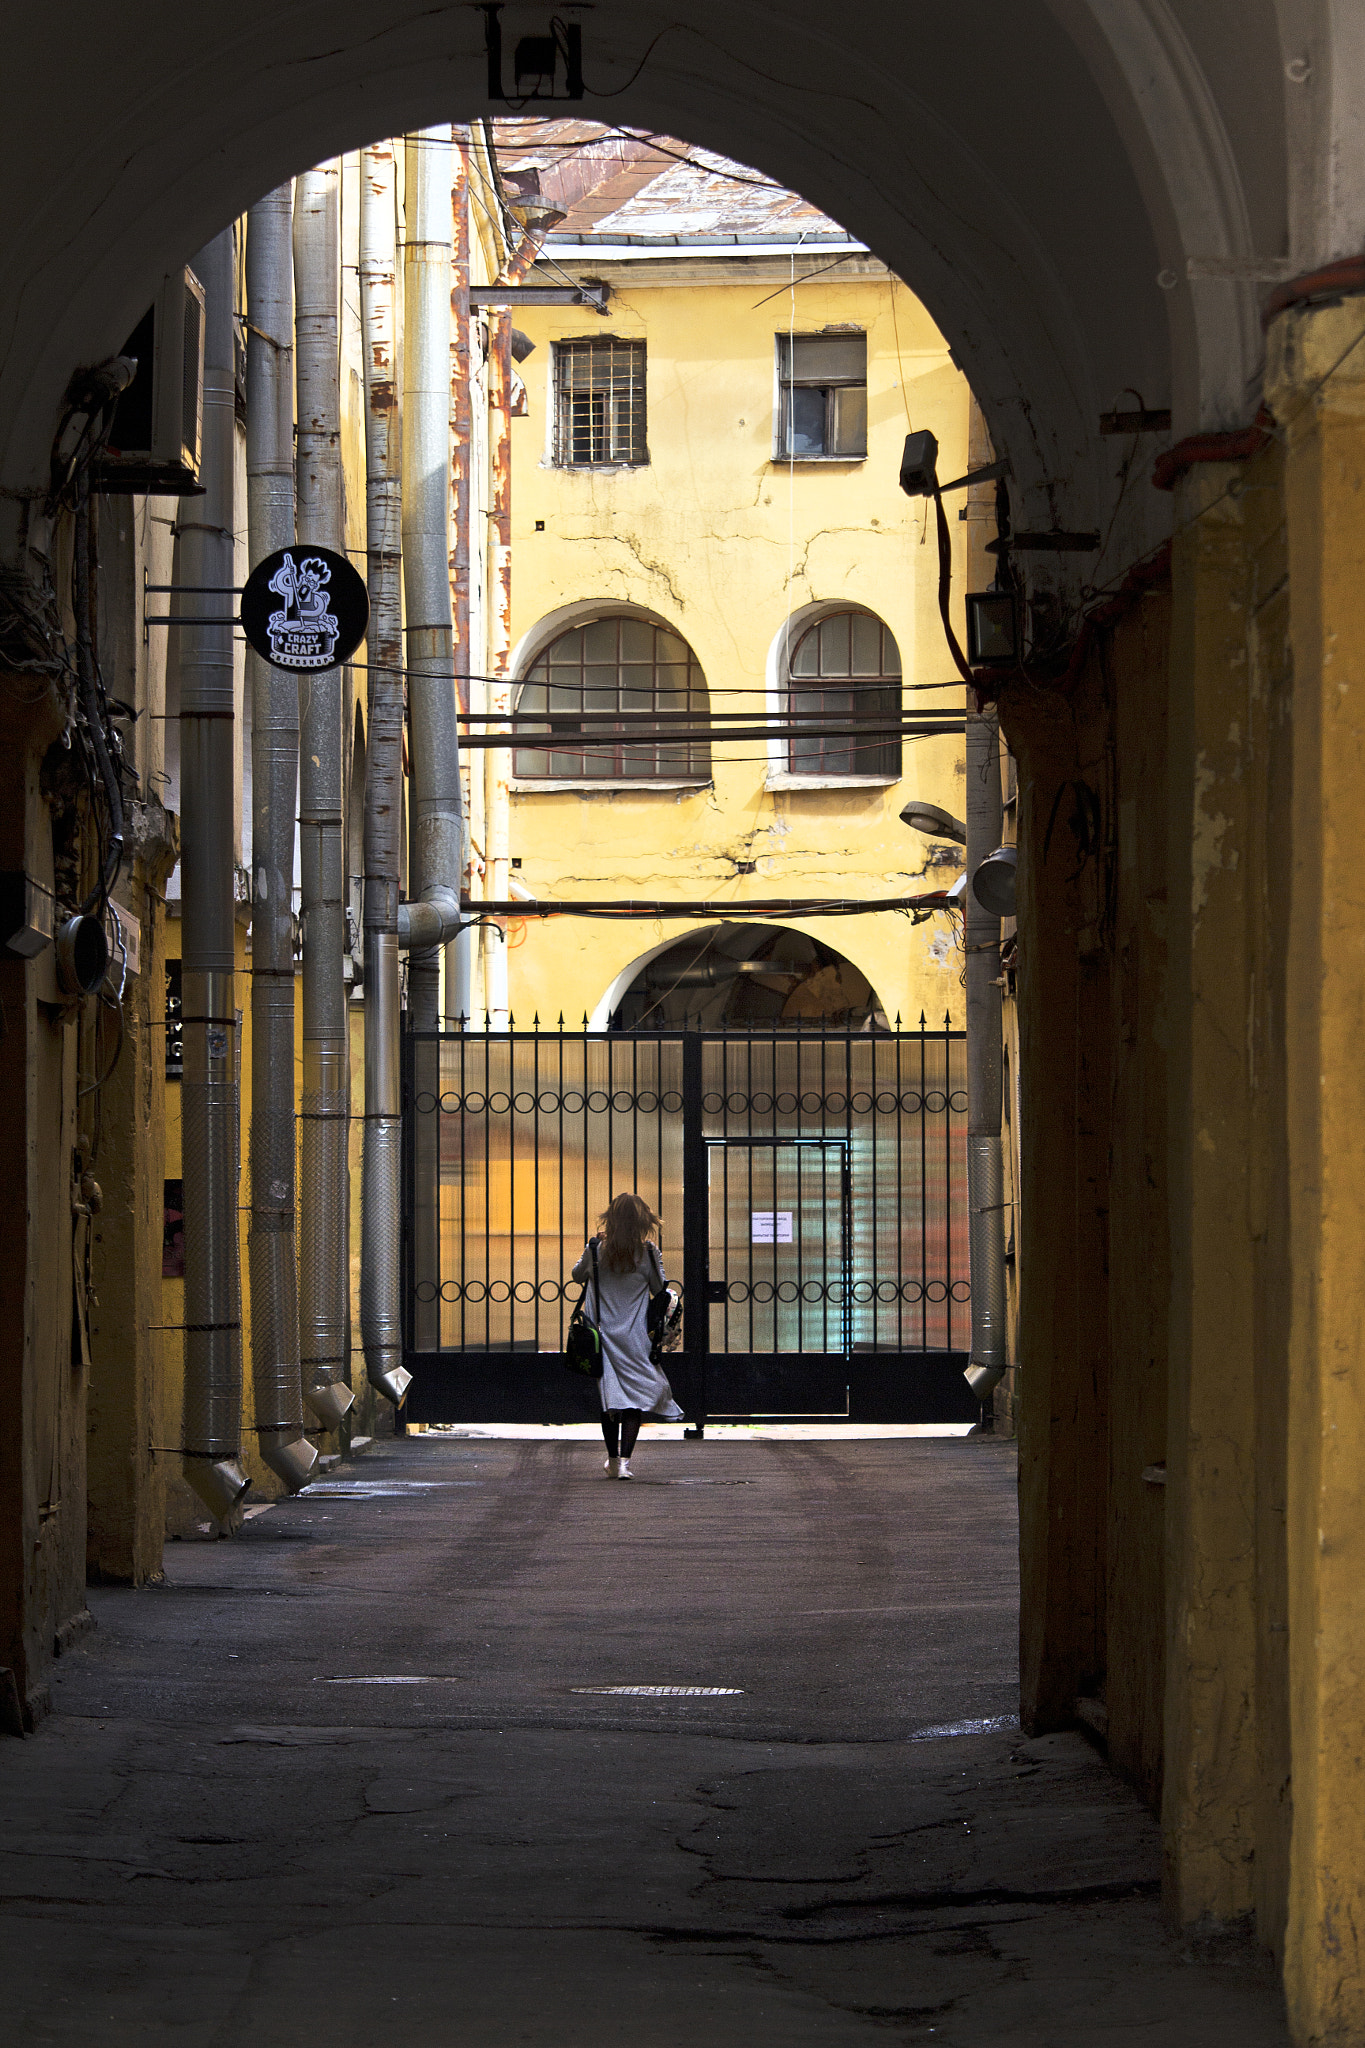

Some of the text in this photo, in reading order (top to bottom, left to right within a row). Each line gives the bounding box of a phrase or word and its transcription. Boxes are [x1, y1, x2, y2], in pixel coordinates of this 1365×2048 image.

[288, 634, 319, 643] CRAZY
[284, 642, 322, 655] CRAFT
[276, 655, 329, 665] BEERSHOP
